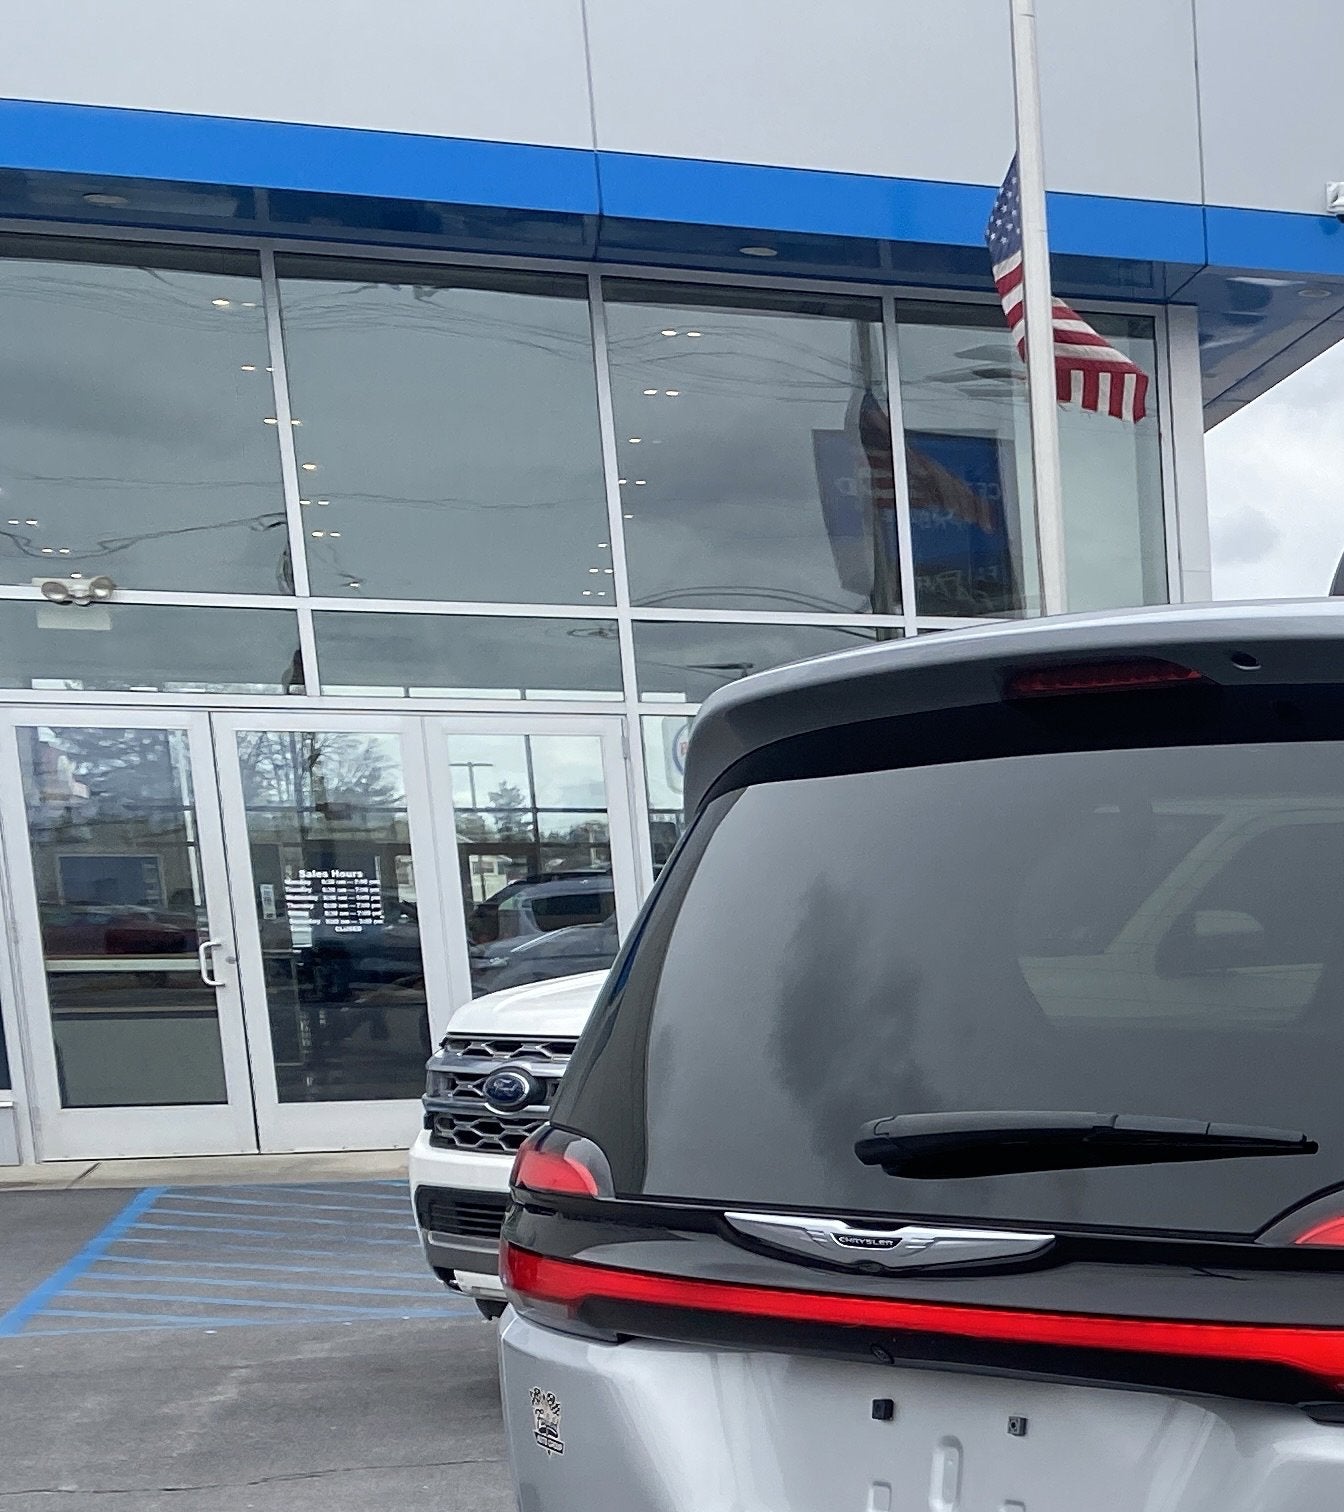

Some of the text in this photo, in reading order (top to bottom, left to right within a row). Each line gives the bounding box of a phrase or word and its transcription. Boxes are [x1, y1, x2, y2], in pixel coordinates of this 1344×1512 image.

[298, 869, 364, 879] Sales Hours
[838, 1236, 894, 1246] CHRYSLER
